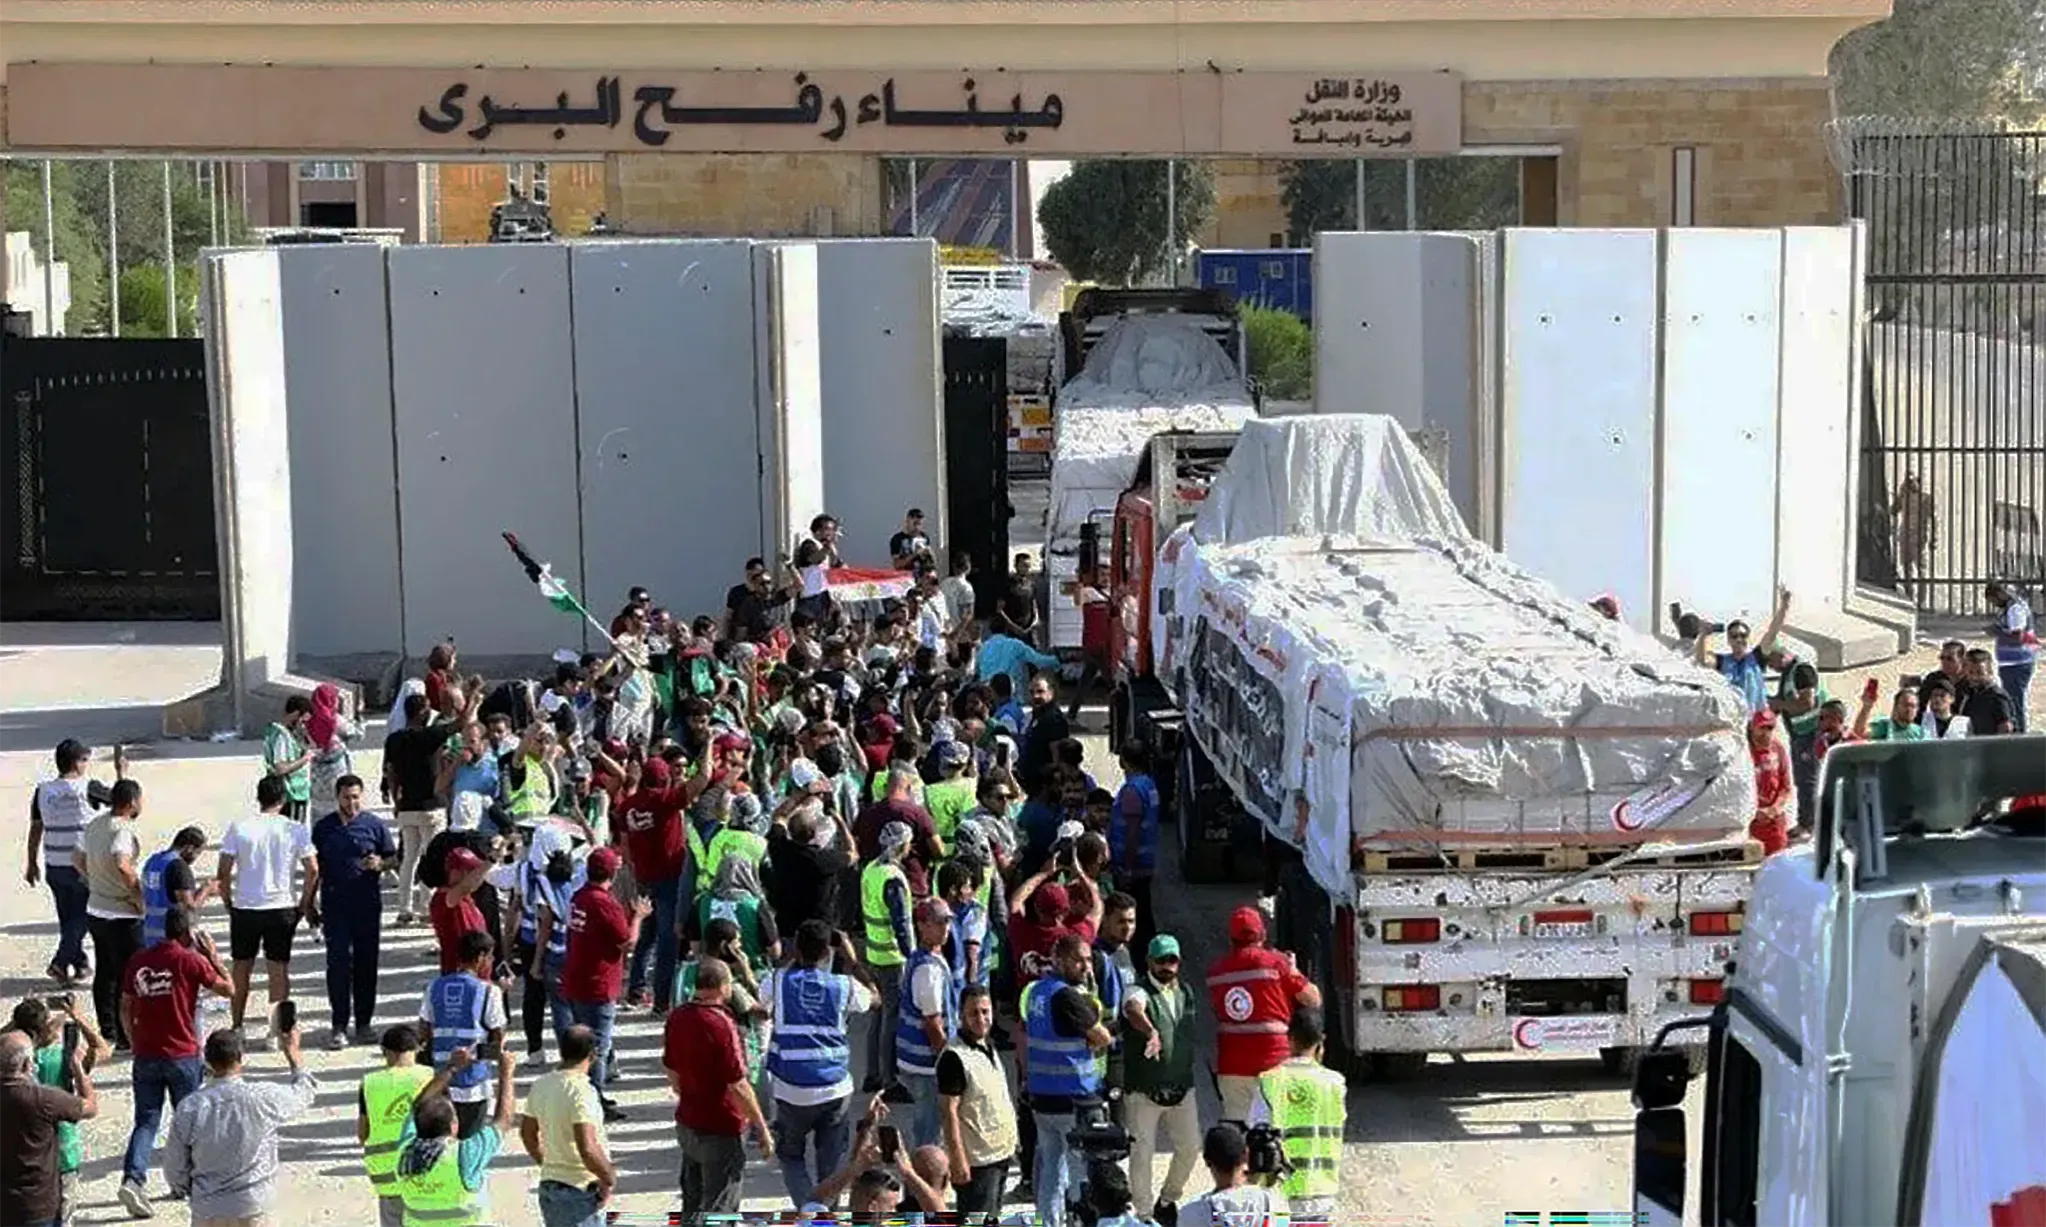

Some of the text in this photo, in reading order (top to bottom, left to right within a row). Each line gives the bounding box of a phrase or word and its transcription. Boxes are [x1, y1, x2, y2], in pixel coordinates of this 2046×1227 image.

[633, 71, 847, 146] رفح
[857, 77, 1063, 143] ميناء
[1305, 79, 1401, 104] وزارة النقل
